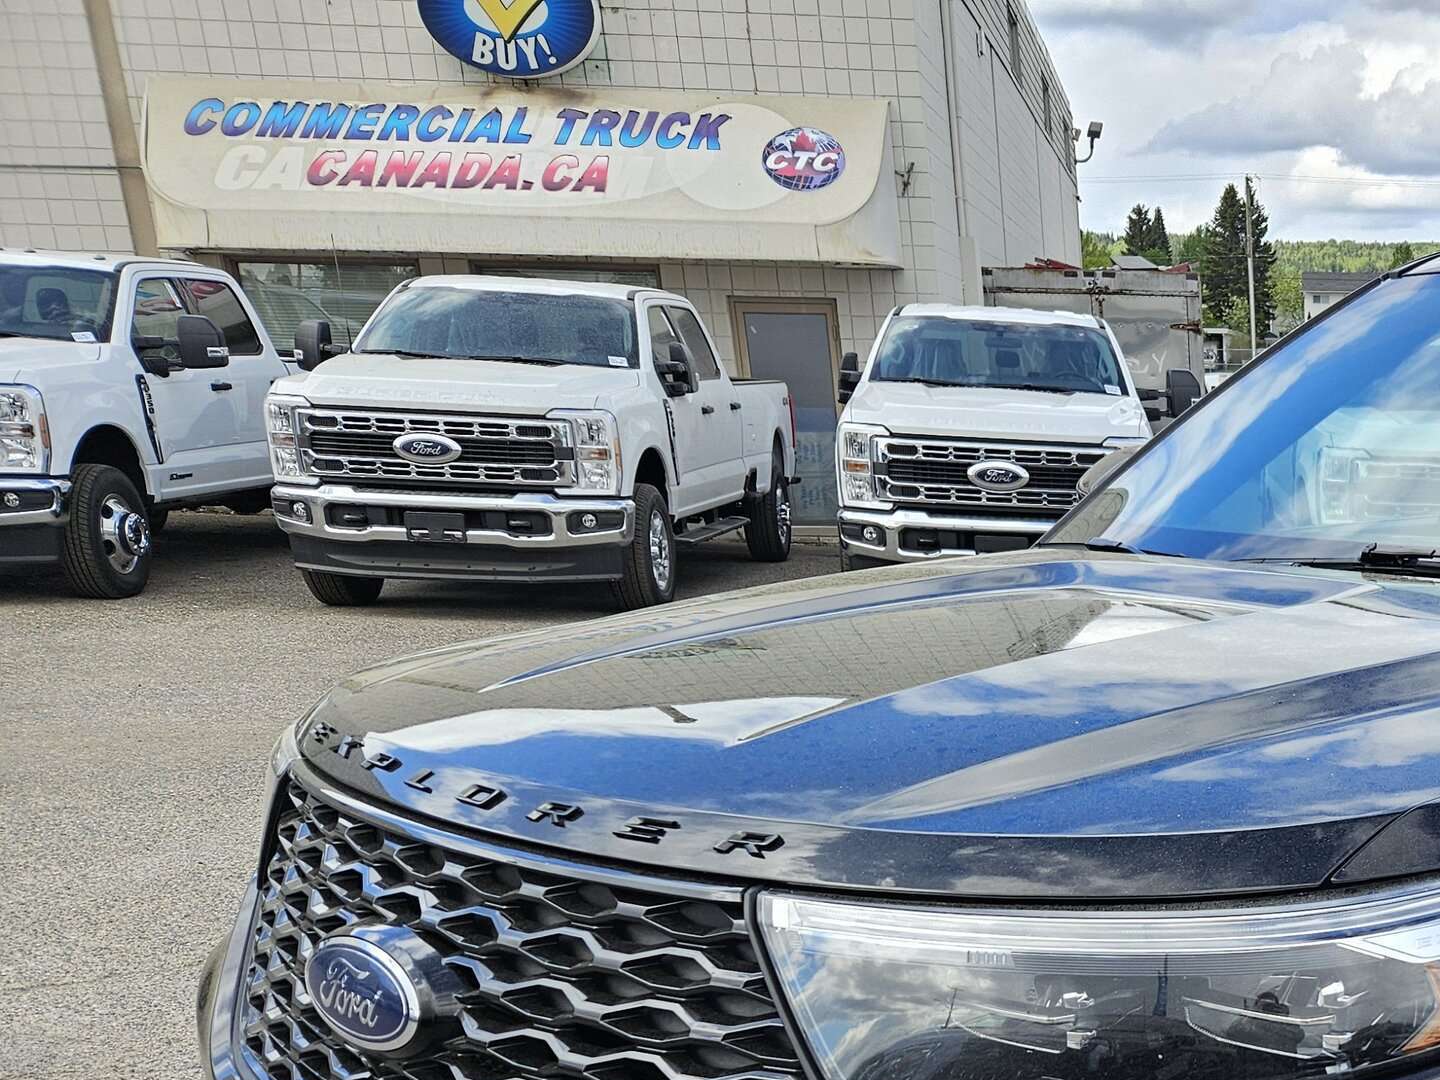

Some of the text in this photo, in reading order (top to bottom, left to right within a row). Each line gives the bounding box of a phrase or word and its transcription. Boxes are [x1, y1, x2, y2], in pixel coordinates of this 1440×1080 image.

[472, 31, 557, 71] BUY!
[183, 97, 732, 151] COMMERCIAL TRUCK
[306, 149, 610, 194] CANADA.CA
[765, 149, 841, 173] CTC
[410, 441, 442, 456] Ford
[983, 468, 1013, 484] Ford
[311, 719, 787, 860] EXPLORER
[319, 956, 384, 1028] Ford
